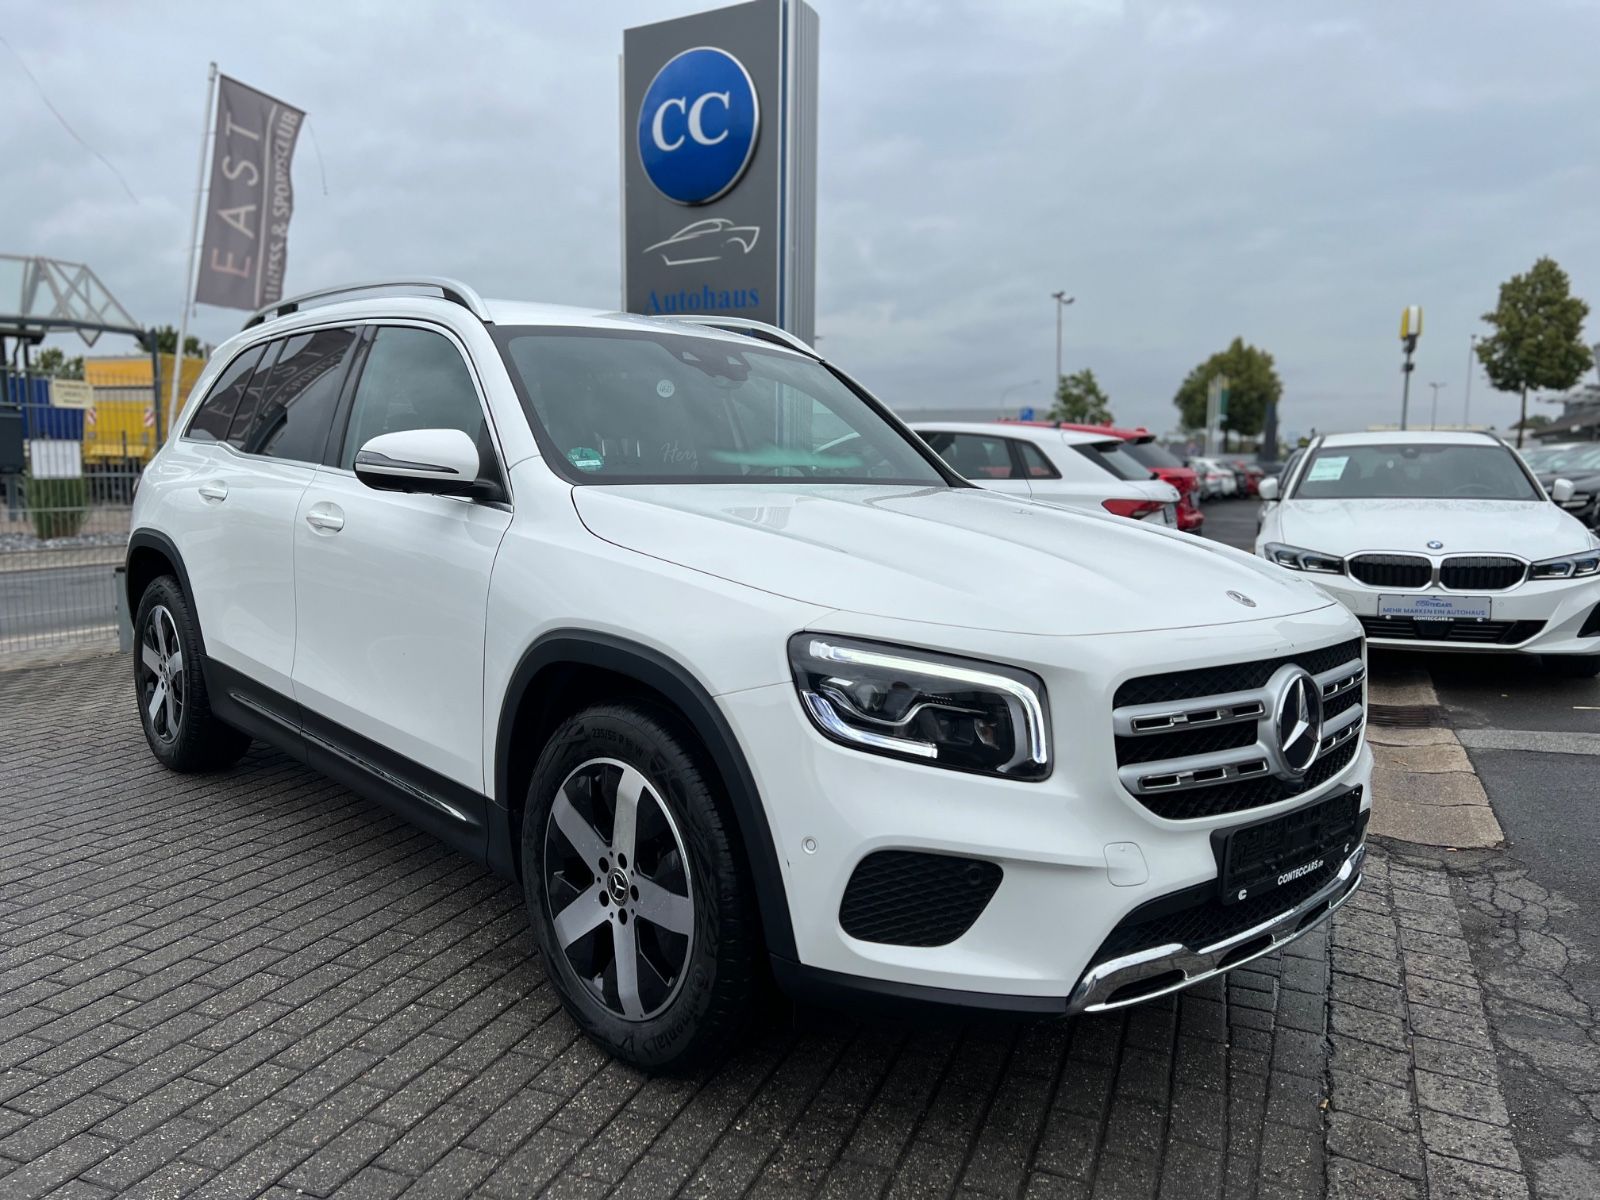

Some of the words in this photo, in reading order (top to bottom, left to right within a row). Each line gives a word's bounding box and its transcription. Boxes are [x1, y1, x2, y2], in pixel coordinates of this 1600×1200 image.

[652, 91, 730, 151] CC
[211, 112, 260, 278] EAST
[643, 283, 761, 316] Autohaus
